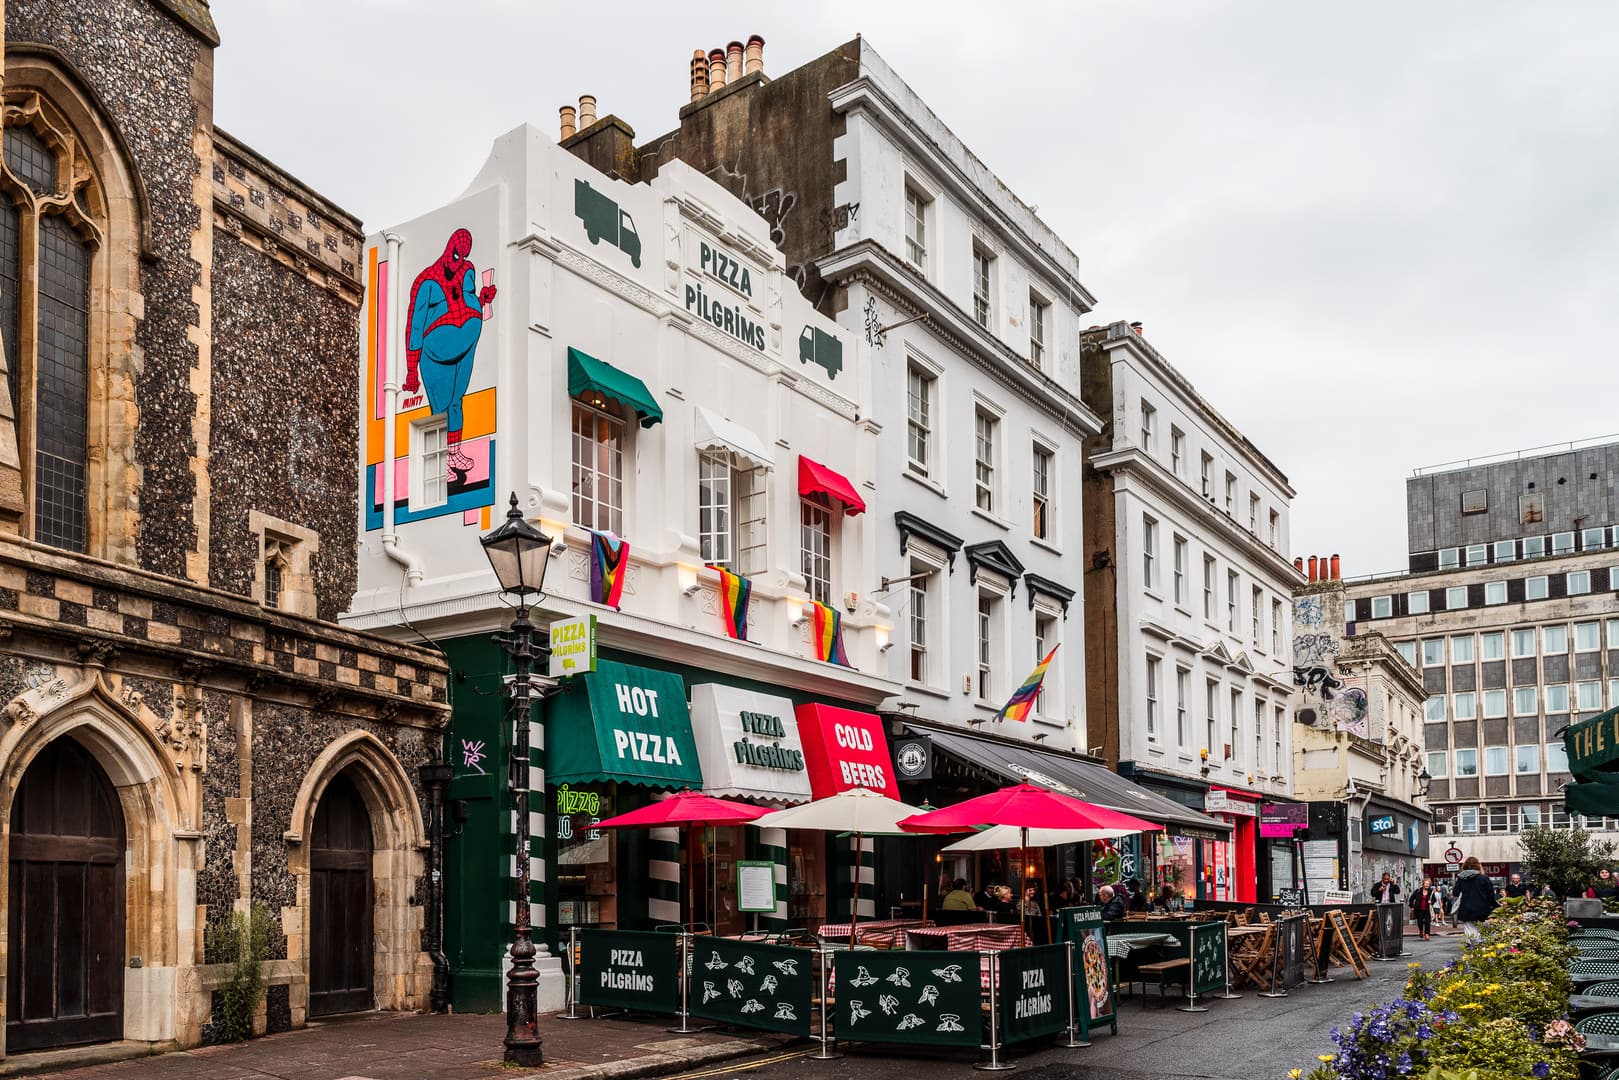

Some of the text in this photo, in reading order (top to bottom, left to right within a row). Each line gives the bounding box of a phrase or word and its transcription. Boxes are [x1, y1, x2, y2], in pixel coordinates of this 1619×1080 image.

[700, 241, 752, 297] PIZZA
[685, 283, 765, 351] PILGRIMS
[402, 395, 424, 409] MINTY
[552, 622, 586, 644] PIZZA
[552, 641, 586, 657] PILGRIMS
[615, 683, 659, 718] HOT
[739, 710, 786, 738] PIZZA
[834, 723, 873, 751] COLD
[613, 729, 683, 766] PIZZA
[733, 737, 805, 771] PILGRIMS
[1574, 720, 1605, 761] THE
[839, 761, 887, 789] BEERS
[1373, 819, 1392, 830] sta
[611, 949, 644, 967] PIZZA
[600, 968, 653, 992] PILGRIMS
[1022, 968, 1045, 989] PIZZA
[1015, 991, 1051, 1019] PILGRIMS
